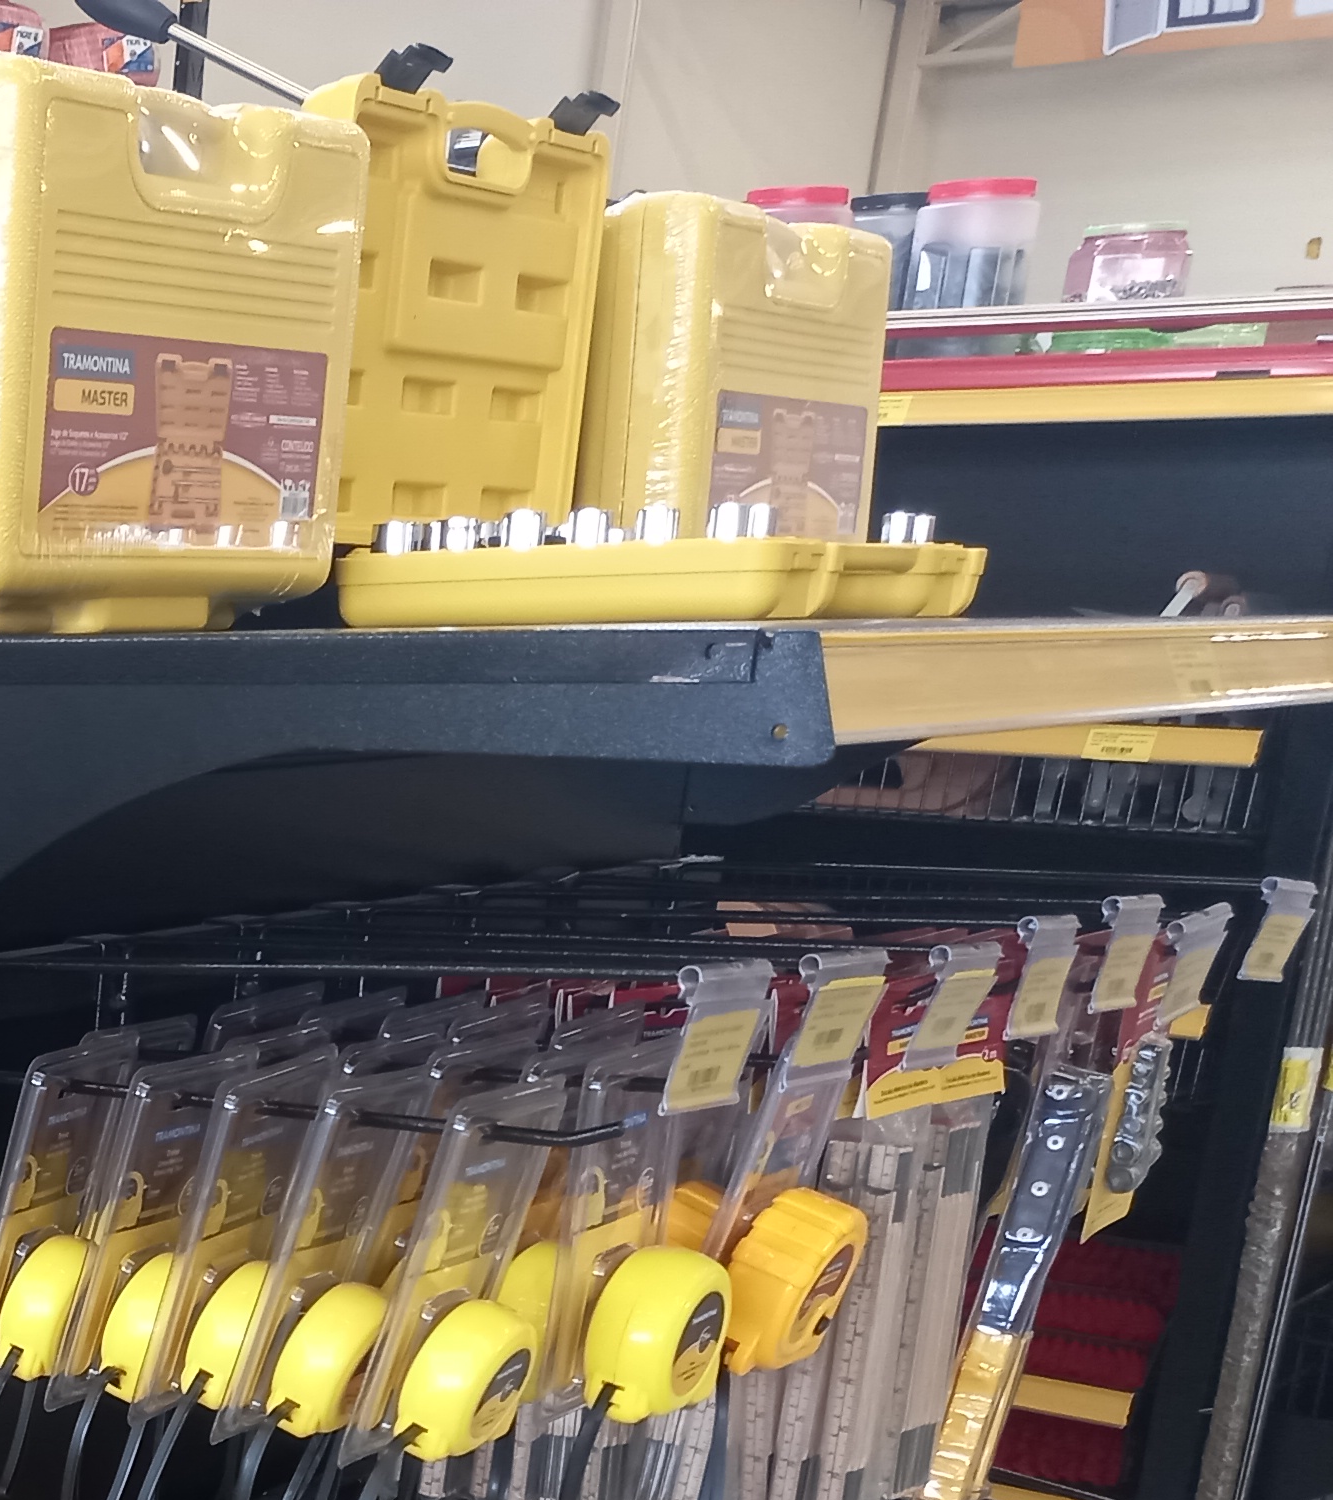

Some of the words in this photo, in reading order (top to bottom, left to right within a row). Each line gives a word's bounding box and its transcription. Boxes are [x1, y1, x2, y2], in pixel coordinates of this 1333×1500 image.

[62, 352, 130, 375] TRAMONTINA
[80, 388, 128, 408] MASTER
[73, 467, 89, 492] 17
